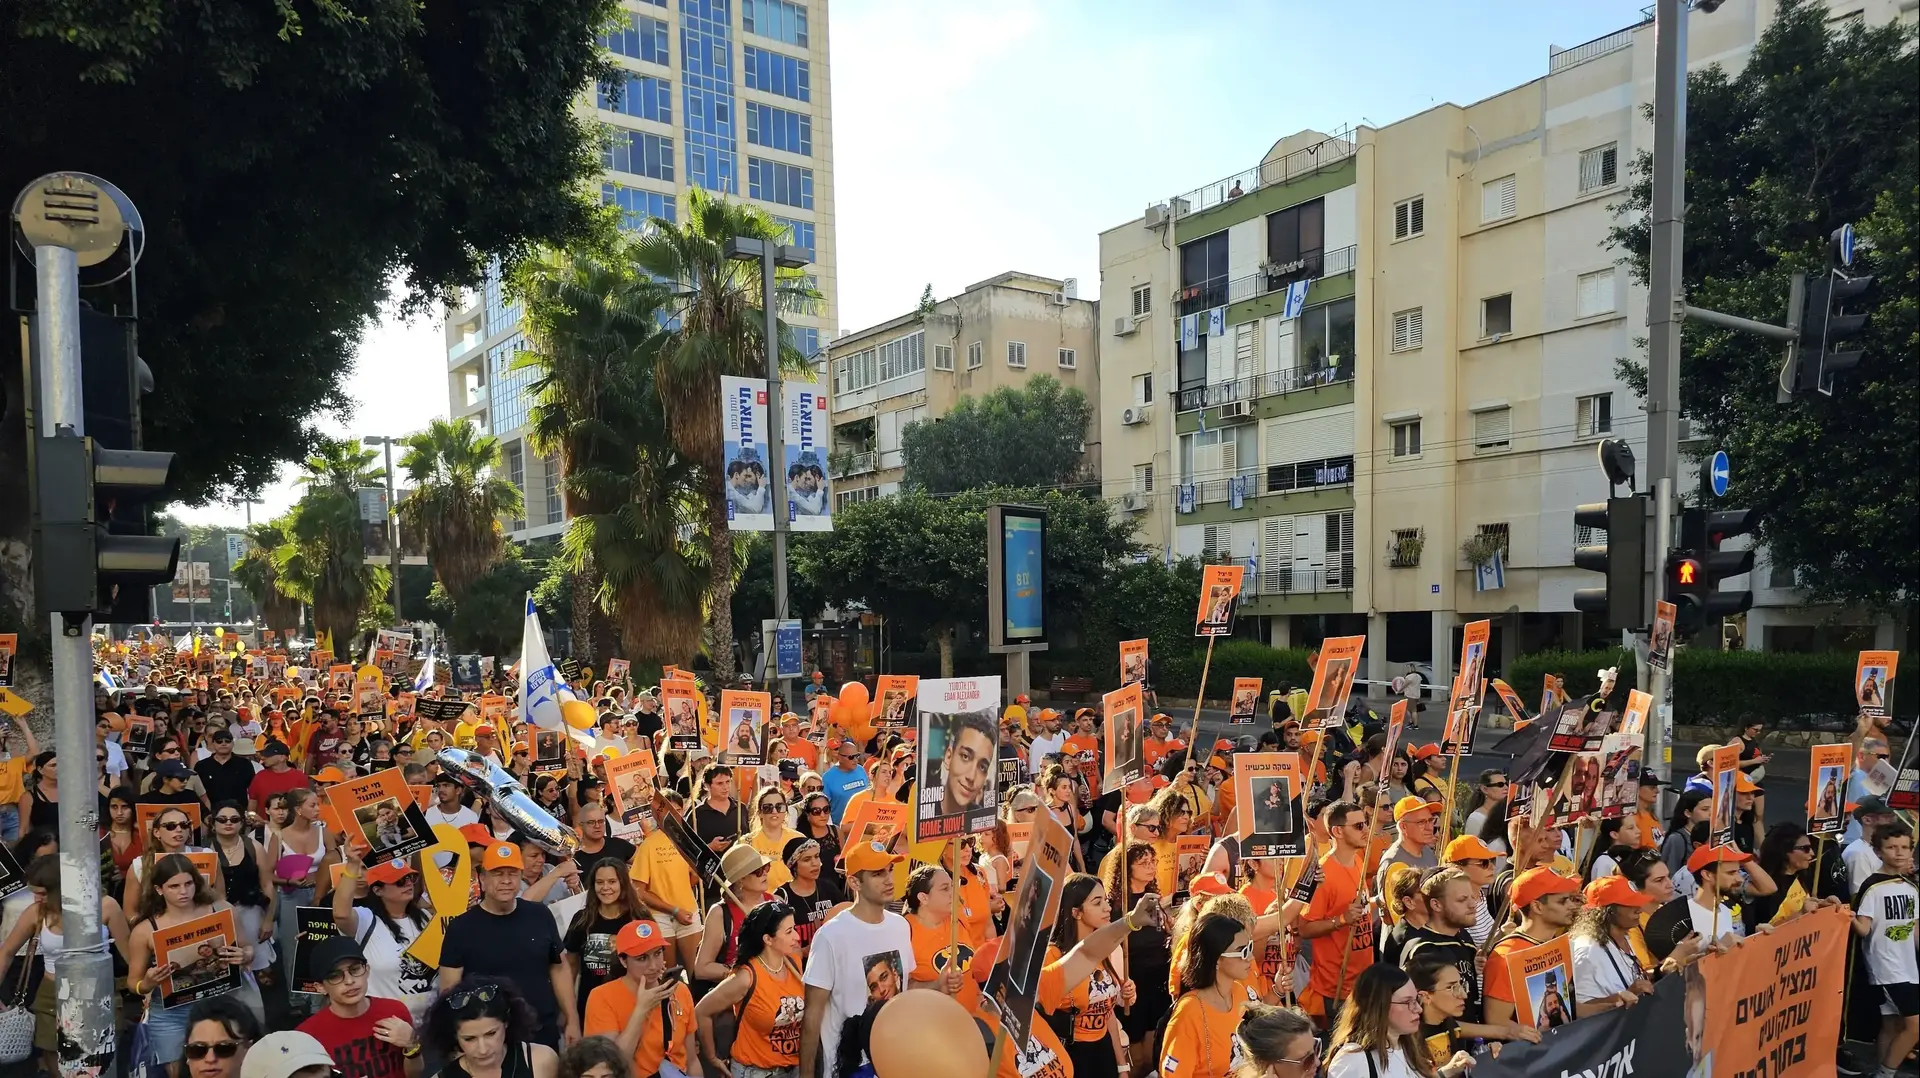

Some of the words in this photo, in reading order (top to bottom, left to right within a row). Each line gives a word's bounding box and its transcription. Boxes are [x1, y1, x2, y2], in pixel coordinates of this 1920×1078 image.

[739, 387, 752, 446] תיאודור
[800, 392, 812, 450] תיאודור
[944, 692, 956, 701] EDAN
[957, 691, 980, 700] ALEXANDER
[1900, 768, 1918, 780] BRIN
[352, 785, 369, 795] יציל
[357, 790, 385, 803] אותנו?
[920, 786, 944, 803] BRING
[920, 803, 936, 820] HIM
[920, 820, 942, 837] HOME
[943, 814, 965, 834] NOW!
[392, 849, 402, 857] 5
[1268, 845, 1276, 855] 5
[308, 921, 328, 929] איפה
[166, 935, 182, 946] FREE
[183, 932, 195, 941] MY
[196, 923, 223, 937] FAMILY!
[308, 932, 328, 941] איפה
[1549, 954, 1563, 965] מגיע
[1774, 942, 1791, 976] עף
[1524, 962, 1547, 973] חופש
[1780, 966, 1817, 1000] ומציל
[195, 990, 204, 1000] 5
[1736, 982, 1776, 1025] אנשים
[1759, 999, 1812, 1050] שתקועים
[1771, 1032, 1807, 1078] בתוך
